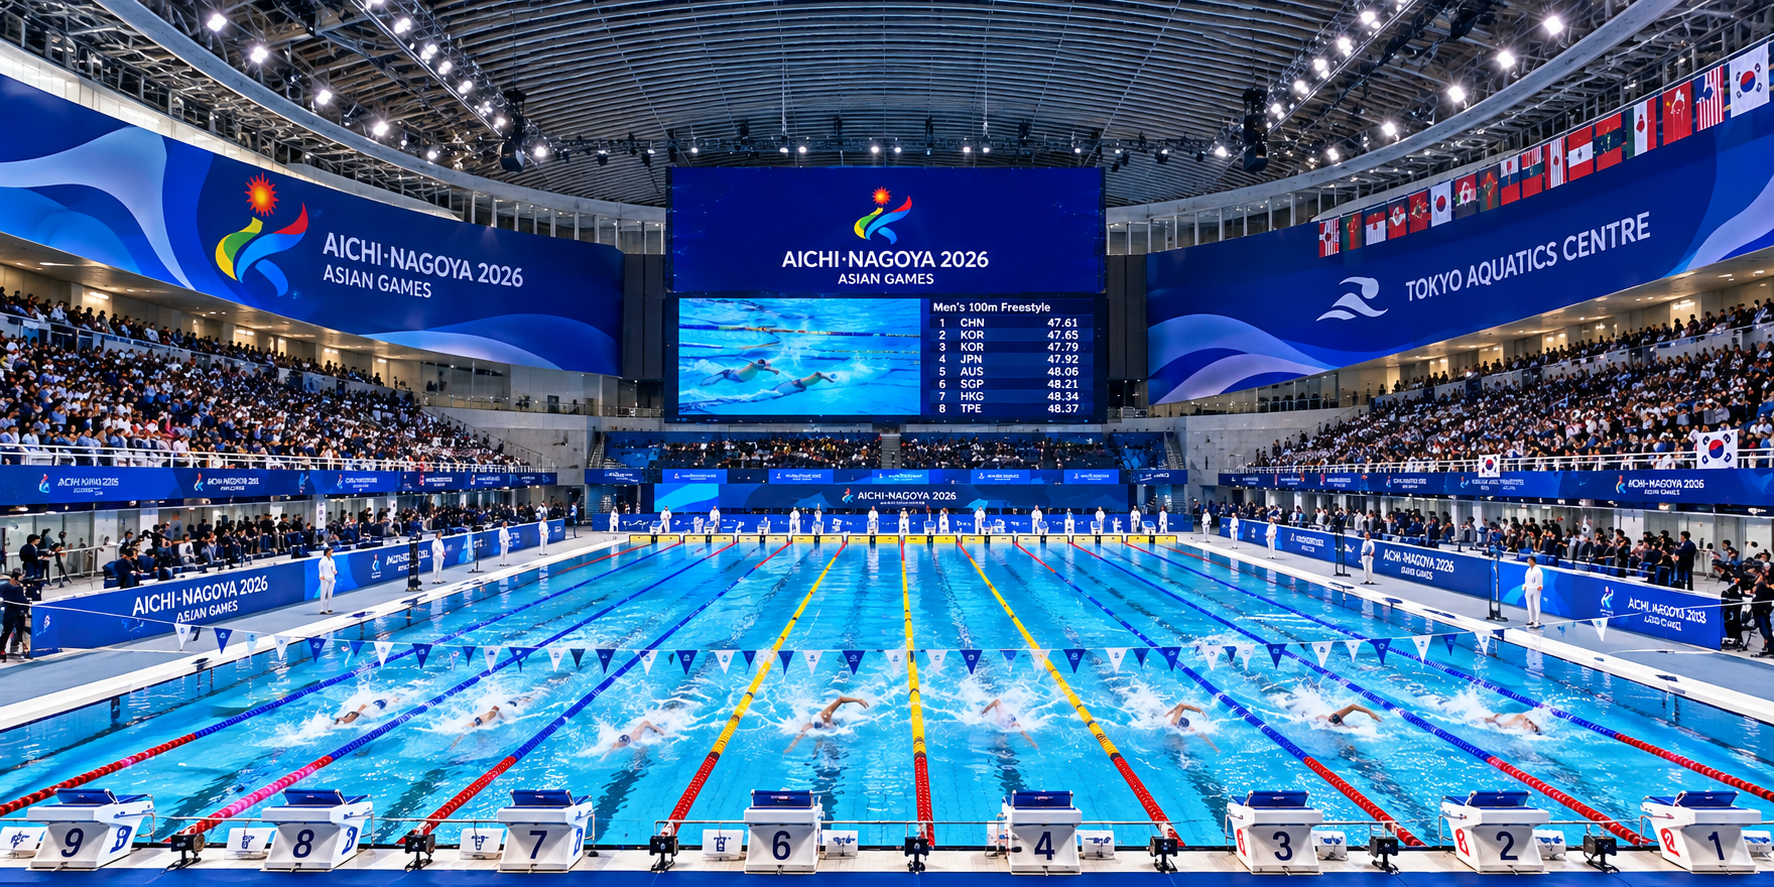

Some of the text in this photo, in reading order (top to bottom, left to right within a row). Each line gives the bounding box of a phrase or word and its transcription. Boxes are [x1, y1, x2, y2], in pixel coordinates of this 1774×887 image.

[940, 250, 989, 268] 2026
[1405, 211, 1651, 302] TOKYO AQUATICS CENTRE
[323, 264, 432, 298] ASIAN GAMES
[477, 262, 524, 288] 2026
[837, 273, 935, 285] ASIAN GAMES
[933, 302, 1051, 314] Men's 100m Freestyle
[938, 318, 1079, 328] 1 CHN 47.61
[938, 330, 1079, 340] 2 KOR 47.65
[938, 342, 1079, 352] 3 KOR 47.79
[938, 354, 1079, 364] 4 JPN 47.92
[938, 367, 1079, 377] 5 AUS 48.06
[938, 379, 1079, 389] 6 SGP 48.21
[938, 391, 1079, 401] 7 HKG 48.34
[938, 404, 1079, 414] 8 TPE 48.37
[857, 491, 957, 500] AICHI-NAGOYA 2026
[132, 575, 268, 617] AICHI-NAGOYA 2026
[61, 827, 84, 858] 9
[292, 828, 315, 859] 8
[529, 830, 548, 860] 7
[772, 830, 791, 861] 6
[1034, 831, 1055, 861] 4
[1273, 831, 1293, 861] 3
[1496, 831, 1519, 861] 2
[1707, 831, 1725, 861] 1
